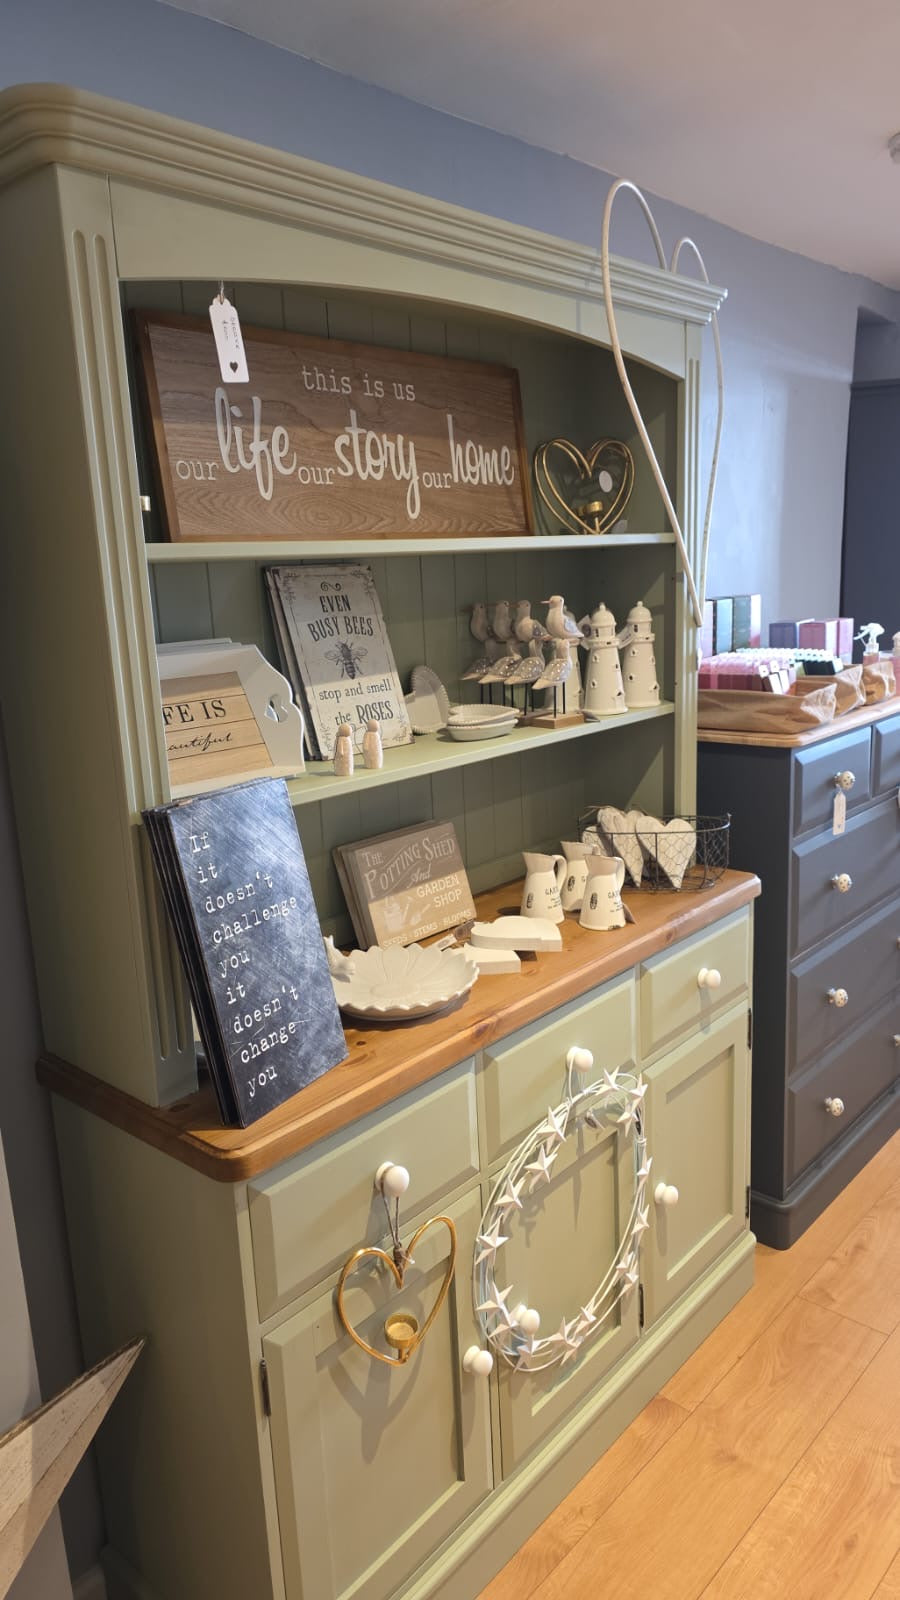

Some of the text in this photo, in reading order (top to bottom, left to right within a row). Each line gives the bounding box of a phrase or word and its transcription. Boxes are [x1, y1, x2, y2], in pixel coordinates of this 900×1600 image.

[301, 365, 416, 401] this is us
[176, 387, 515, 519] our life our story our home
[319, 594, 352, 614] EVEN
[307, 615, 375, 642] BUSY BEES
[318, 678, 392, 704] stop and smell
[161, 699, 227, 726] FE IS
[334, 700, 394, 726] the ROSES
[166, 732, 233, 752] autiful
[188, 832, 210, 855] If
[198, 866, 218, 884] it
[417, 874, 460, 898] GARDEN
[204, 871, 274, 915] doesn't
[434, 888, 462, 908] SHOP
[212, 896, 298, 945] challenge
[218, 951, 250, 979] you
[226, 987, 247, 1006] it
[233, 982, 299, 1035] doesn't
[240, 1020, 298, 1064] change
[247, 1068, 278, 1098] you
